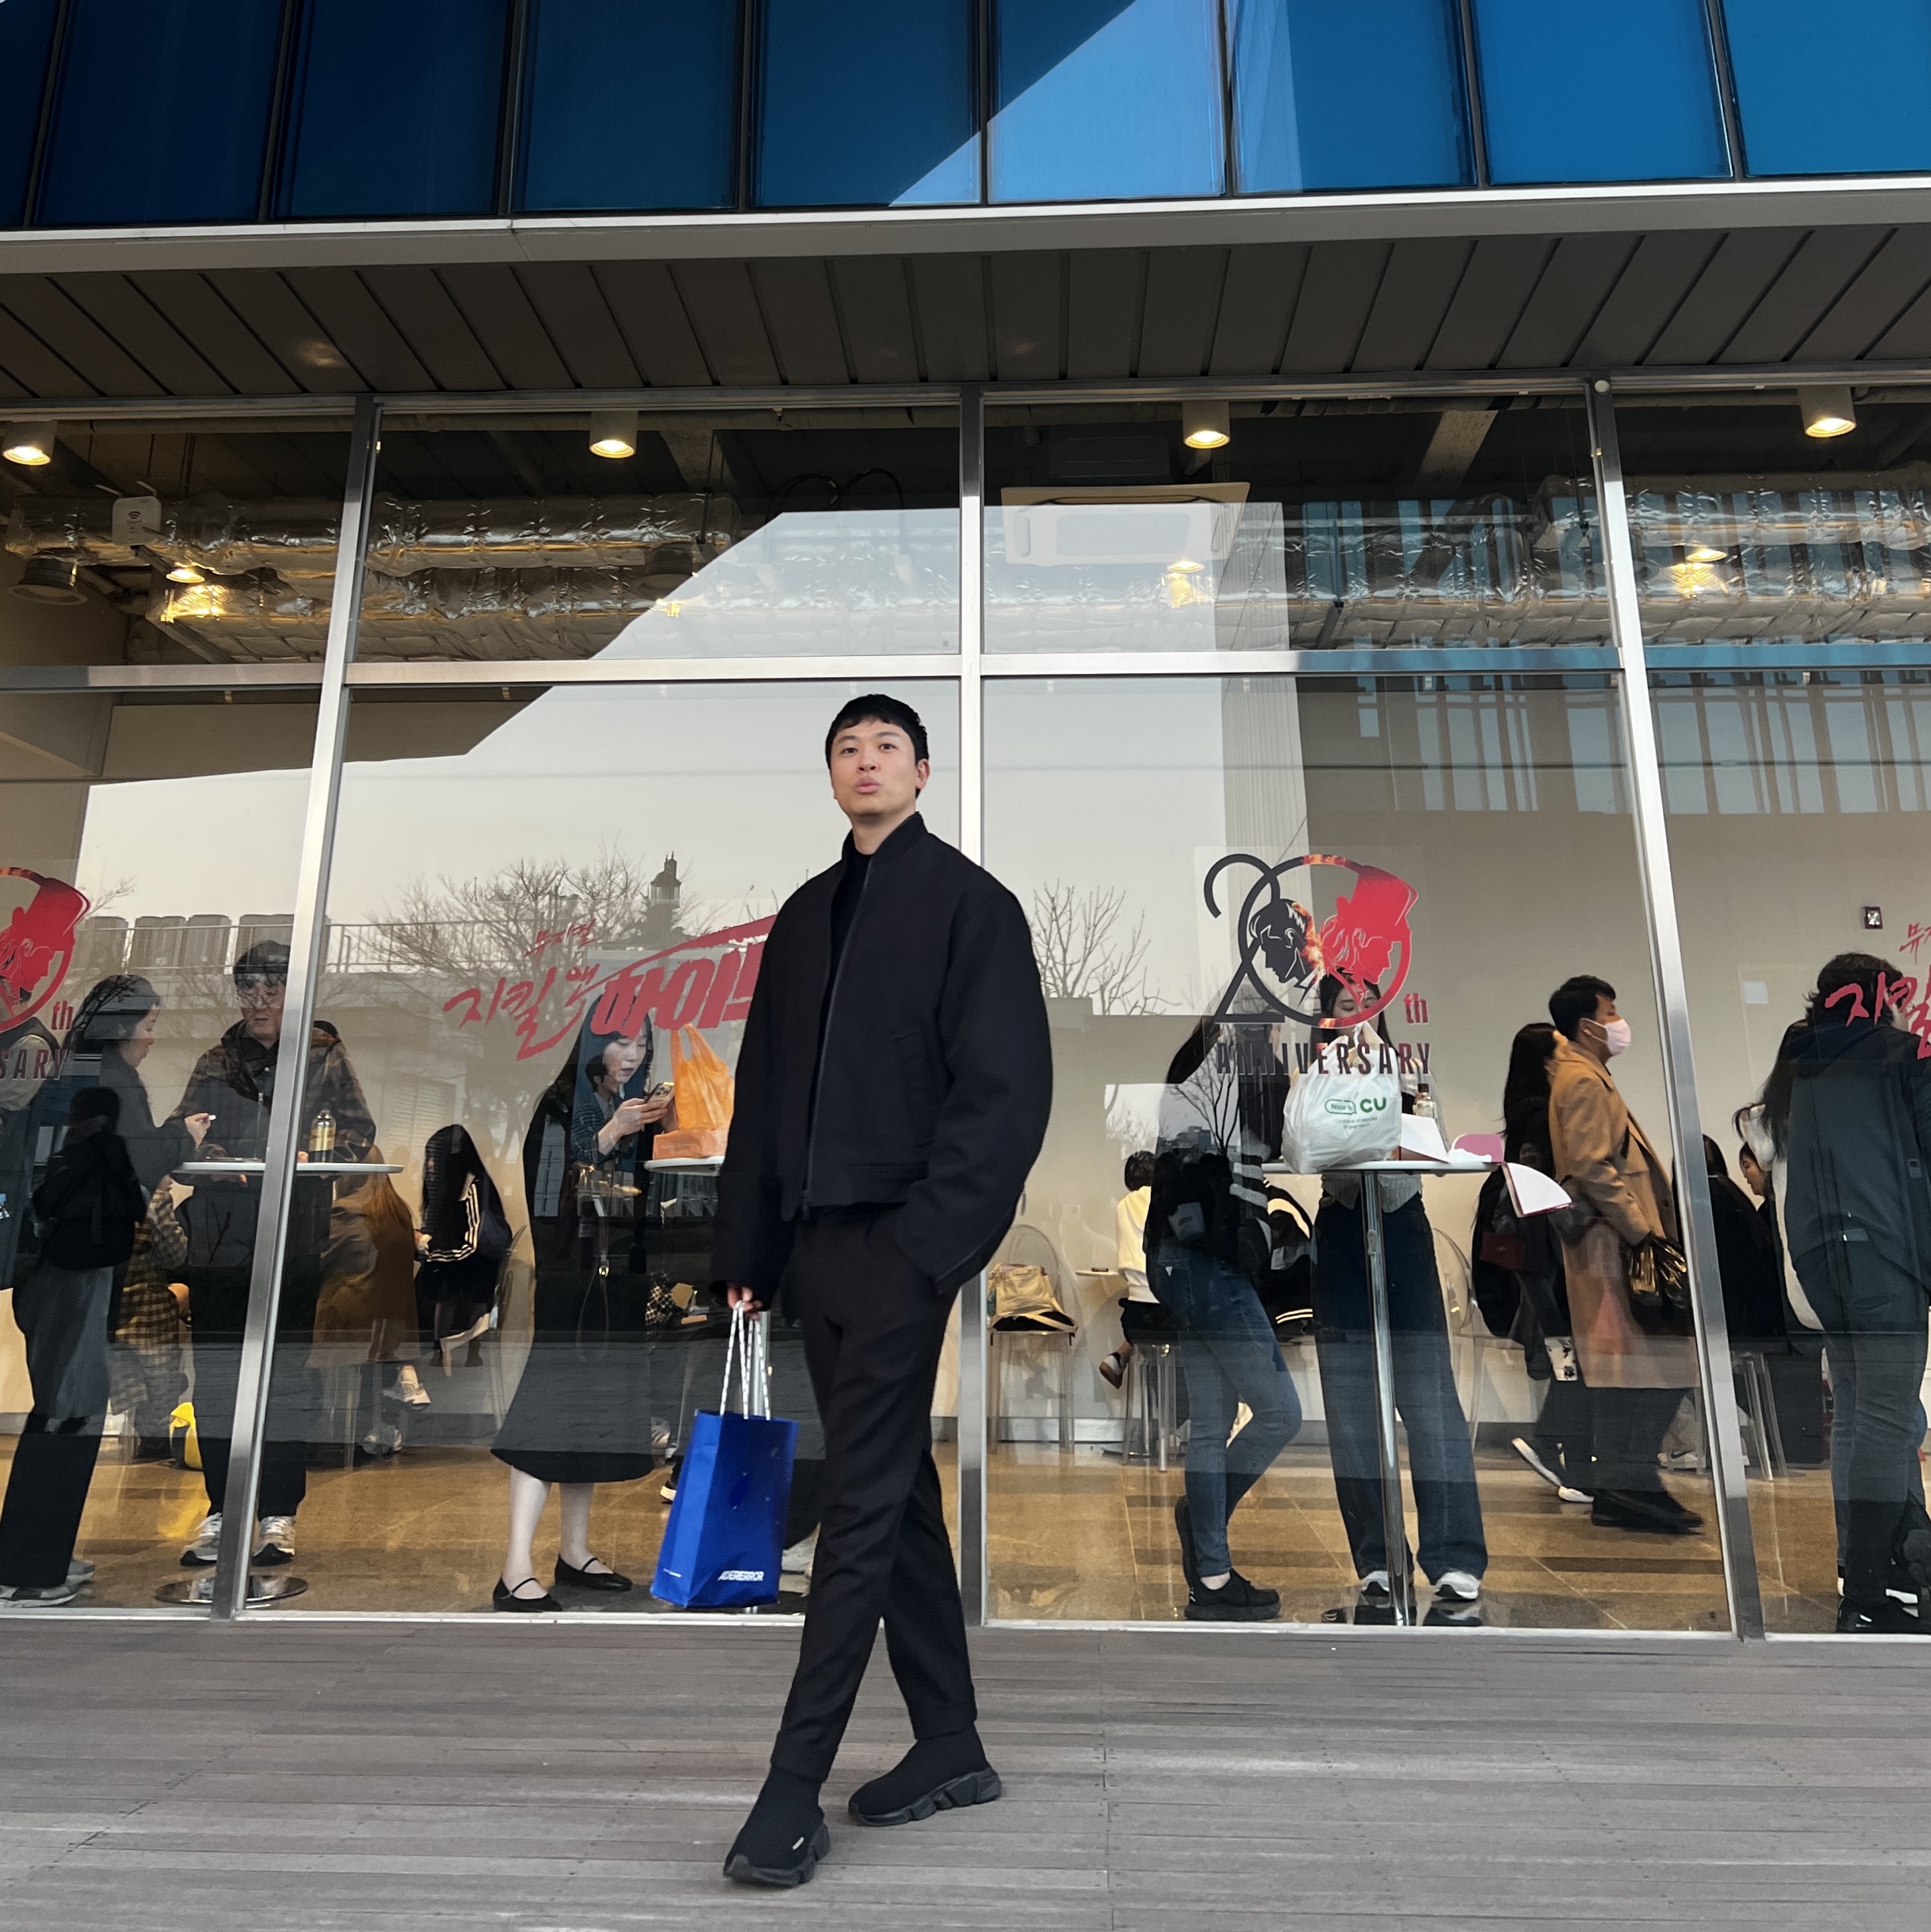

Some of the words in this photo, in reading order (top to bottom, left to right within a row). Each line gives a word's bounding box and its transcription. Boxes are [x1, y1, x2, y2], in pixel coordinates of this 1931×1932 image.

[442, 966, 587, 1061] 지킬
[1216, 1042, 1431, 1076] ANNIVERSARY
[1360, 1096, 1386, 1113] CU
